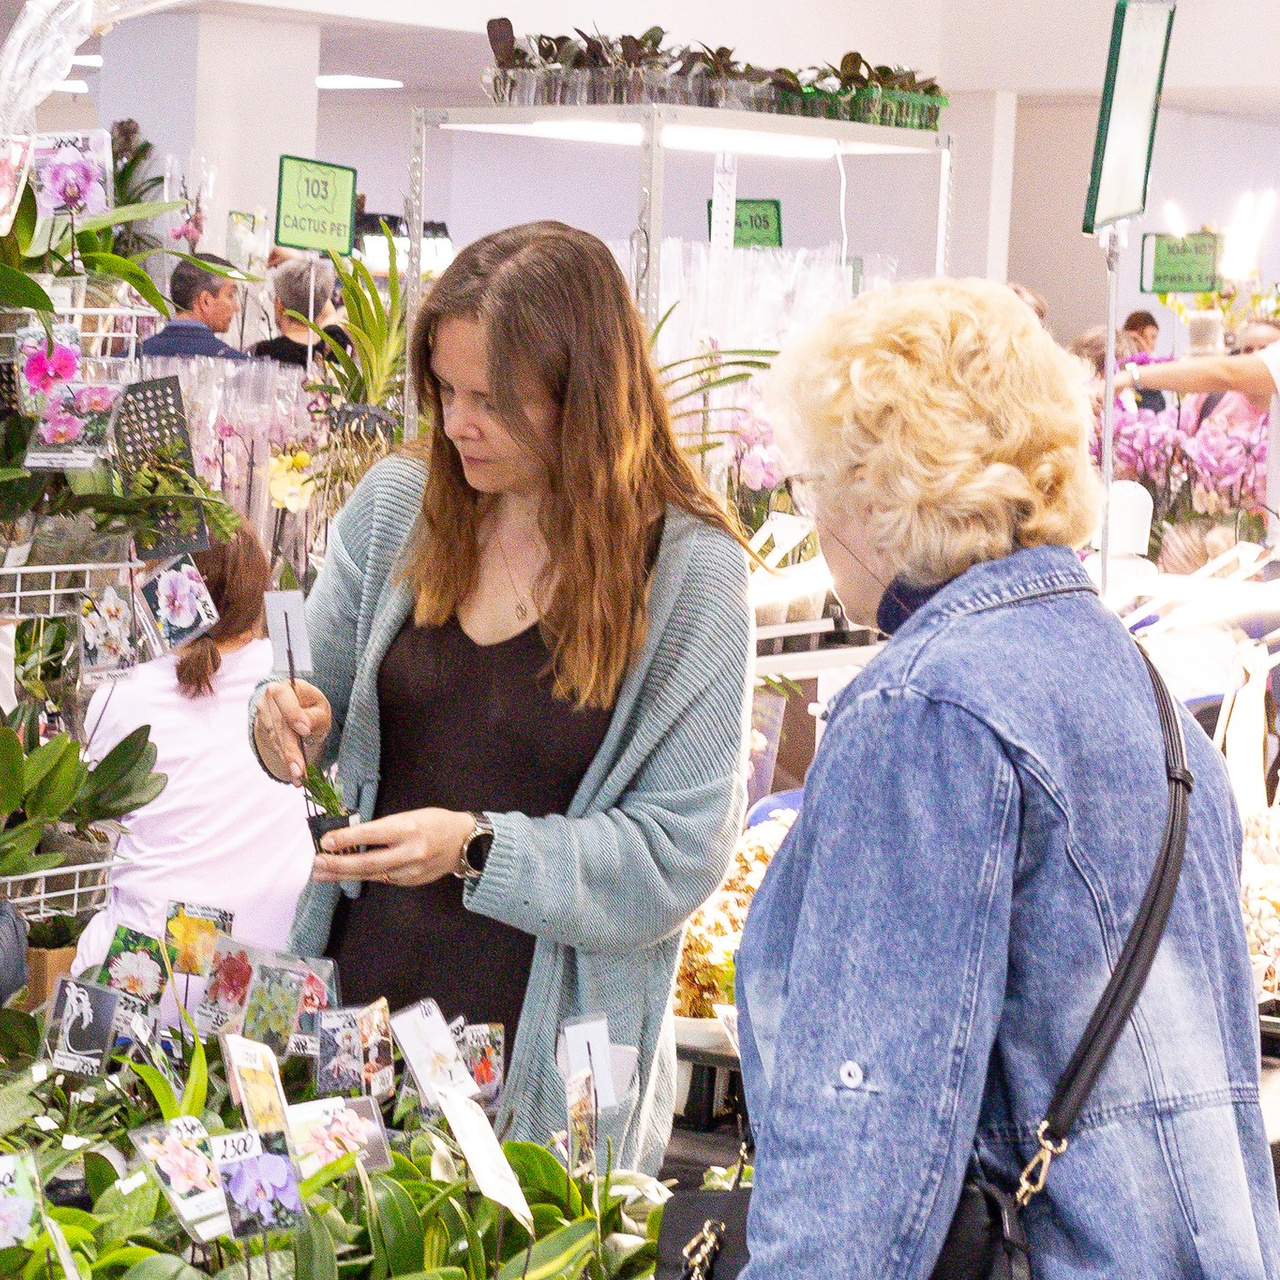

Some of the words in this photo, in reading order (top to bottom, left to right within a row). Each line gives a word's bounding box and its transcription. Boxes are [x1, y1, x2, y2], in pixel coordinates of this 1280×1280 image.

[303, 176, 329, 200] 103
[283, 214, 327, 235] CACTUS
[329, 222, 348, 238] PET
